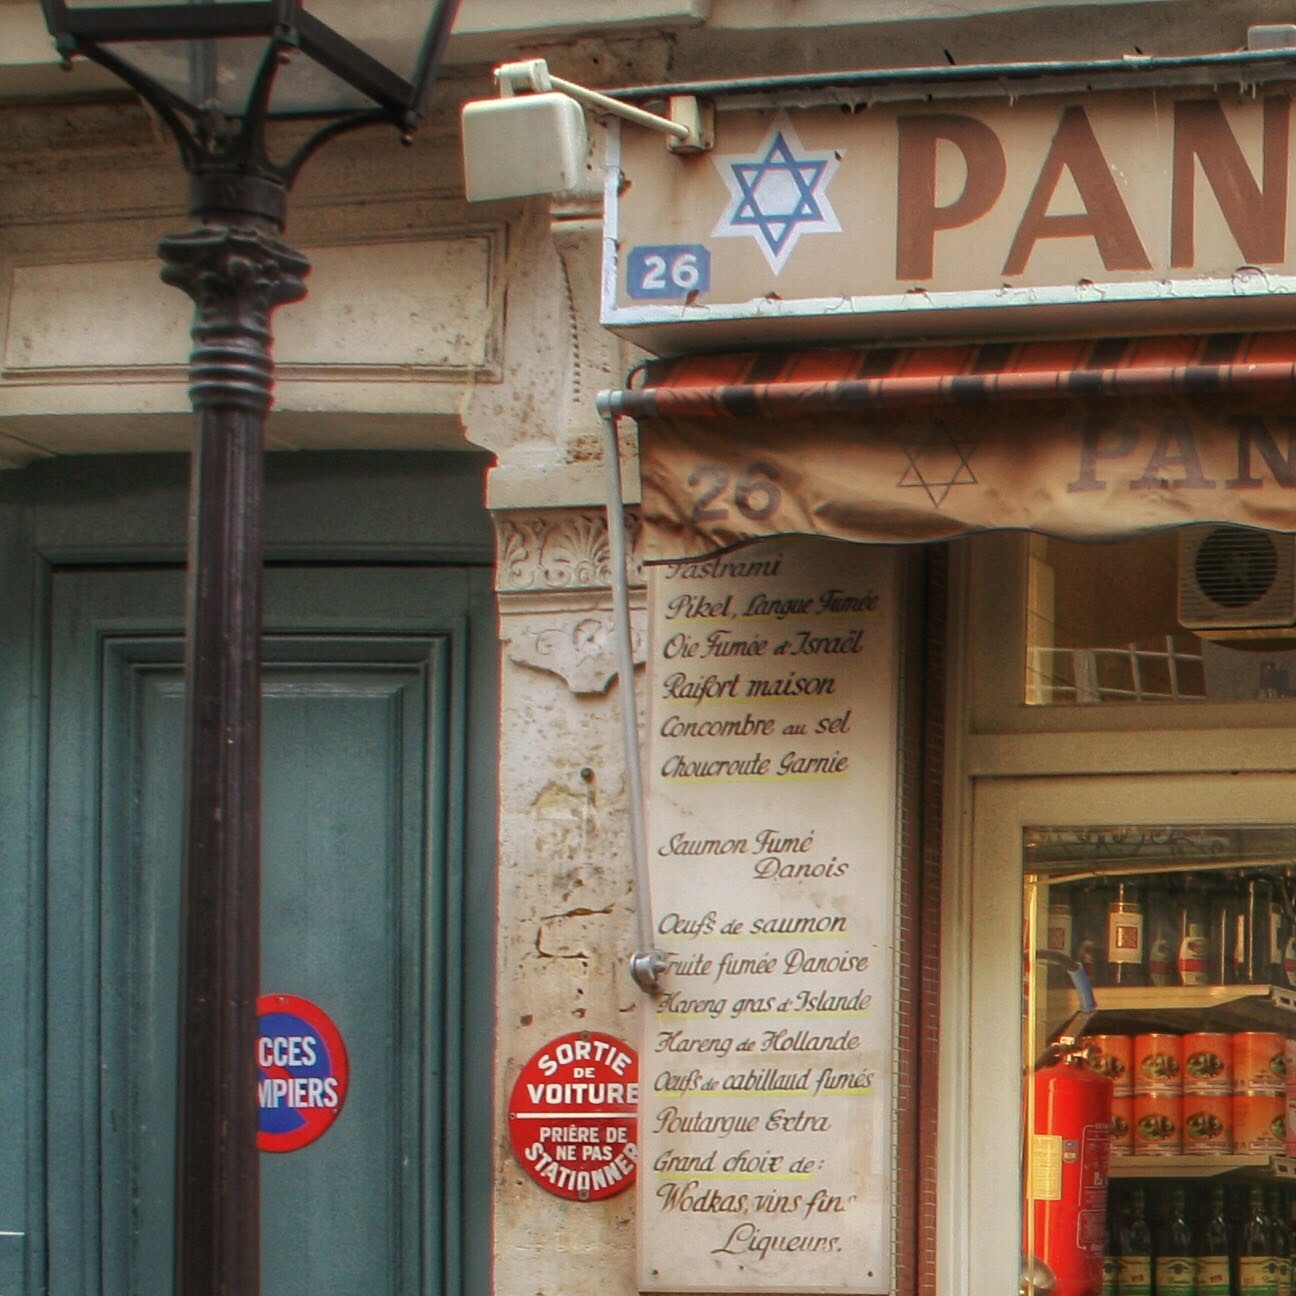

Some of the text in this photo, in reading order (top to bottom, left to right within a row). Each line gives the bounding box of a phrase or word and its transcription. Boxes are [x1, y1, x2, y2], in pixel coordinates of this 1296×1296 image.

[642, 254, 699, 290] 26
[687, 460, 783, 522] 26
[663, 631, 696, 659] Oie
[700, 629, 768, 659] Fumée
[662, 671, 837, 706] Raifort maison
[660, 710, 851, 738] Concombre au sel
[660, 750, 849, 778] Choucroute Garnie
[658, 828, 815, 856] Saumon Fumé
[752, 856, 850, 880] Danois
[719, 919, 744, 935] de
[749, 913, 848, 934] saumon
[714, 951, 778, 984] fumée
[782, 948, 870, 975] Danoise
[657, 991, 726, 1018] Hareng
[730, 998, 773, 1019] gras
[258, 1035, 317, 1067] CCES
[655, 1028, 861, 1058] Hareng de Hollande
[537, 1040, 633, 1077] SORTIE
[572, 1067, 596, 1080] DE
[702, 1077, 718, 1091] de
[722, 1068, 810, 1091] cabillaud
[812, 1067, 875, 1097] fumés
[258, 1075, 339, 1109] MPIERS
[526, 1082, 640, 1105] VOITURE
[539, 1123, 628, 1144] PRIÈRE DE
[652, 1105, 831, 1139] Poutargue Extra
[524, 1142, 640, 1191] STATIONNER
[555, 1145, 613, 1162] NE PAS
[653, 1148, 718, 1173] Grand
[722, 1148, 785, 1174] choix
[753, 1188, 803, 1214] vins
